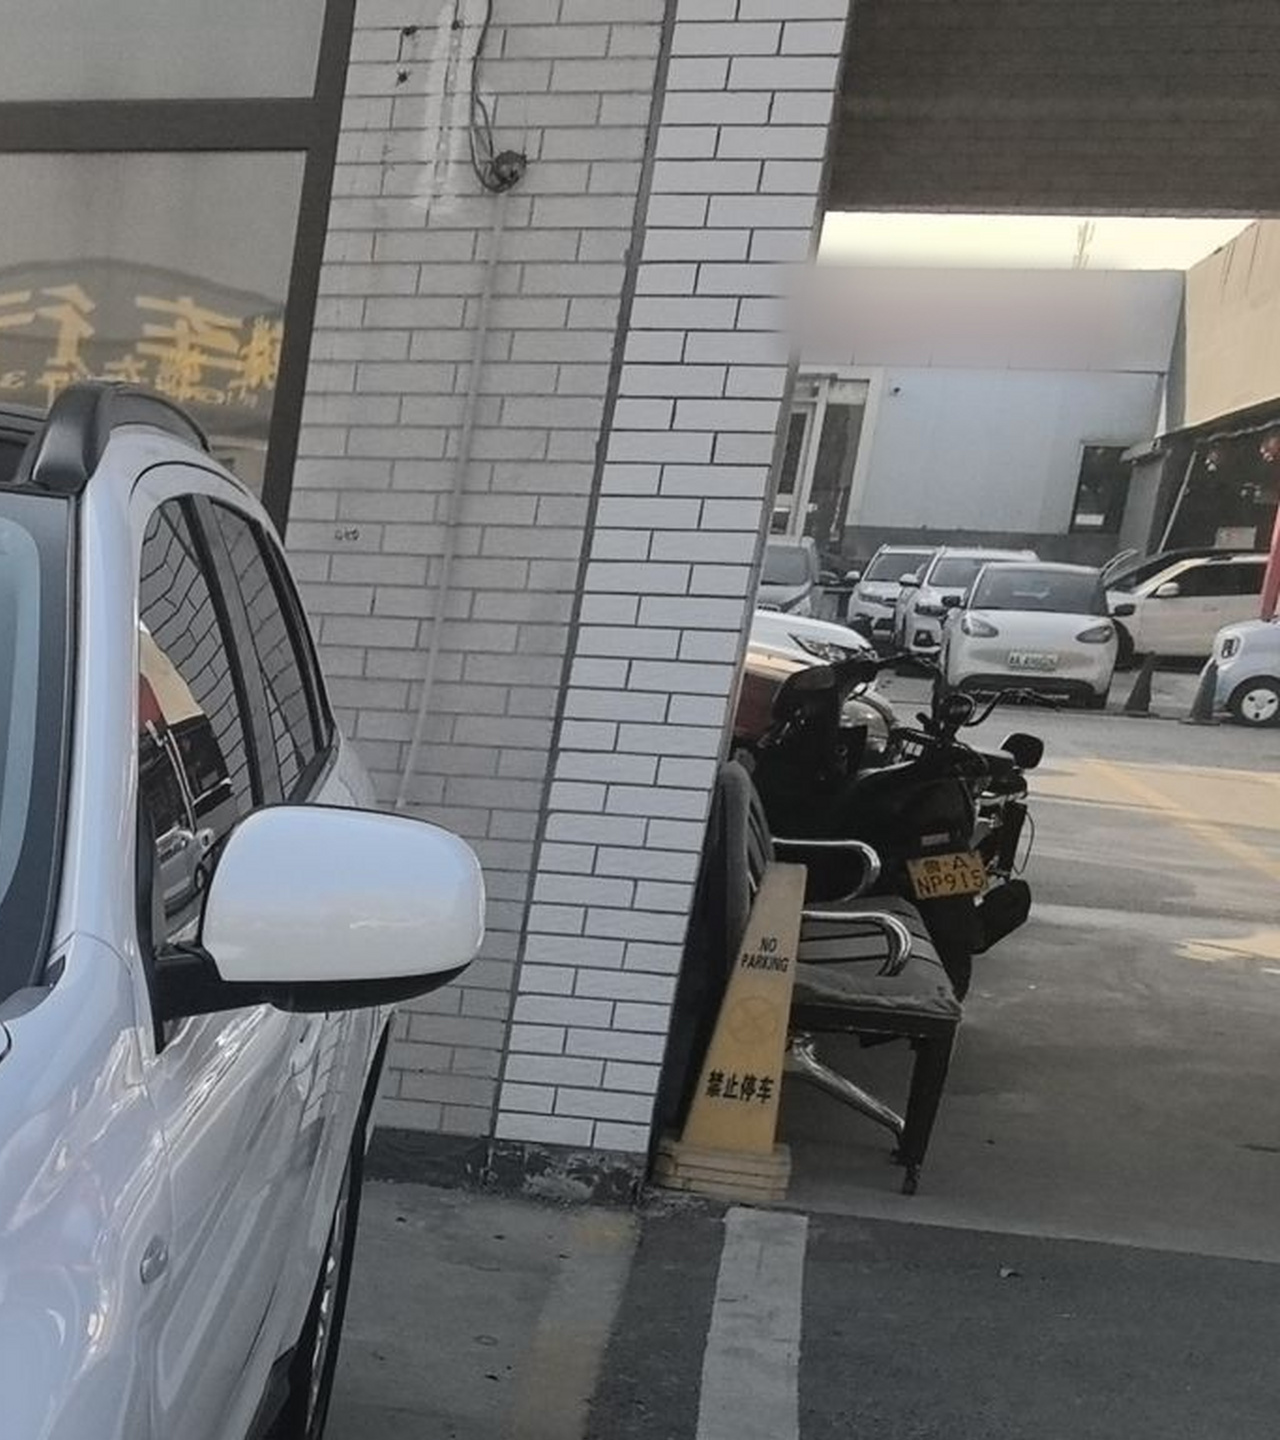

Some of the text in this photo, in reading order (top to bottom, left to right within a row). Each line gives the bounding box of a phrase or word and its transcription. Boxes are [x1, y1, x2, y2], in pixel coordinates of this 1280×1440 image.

[917, 869, 984, 895] NP915
[759, 936, 778, 953] NO
[741, 952, 789, 973] PARKING
[705, 1068, 775, 1104] 禁止停车
